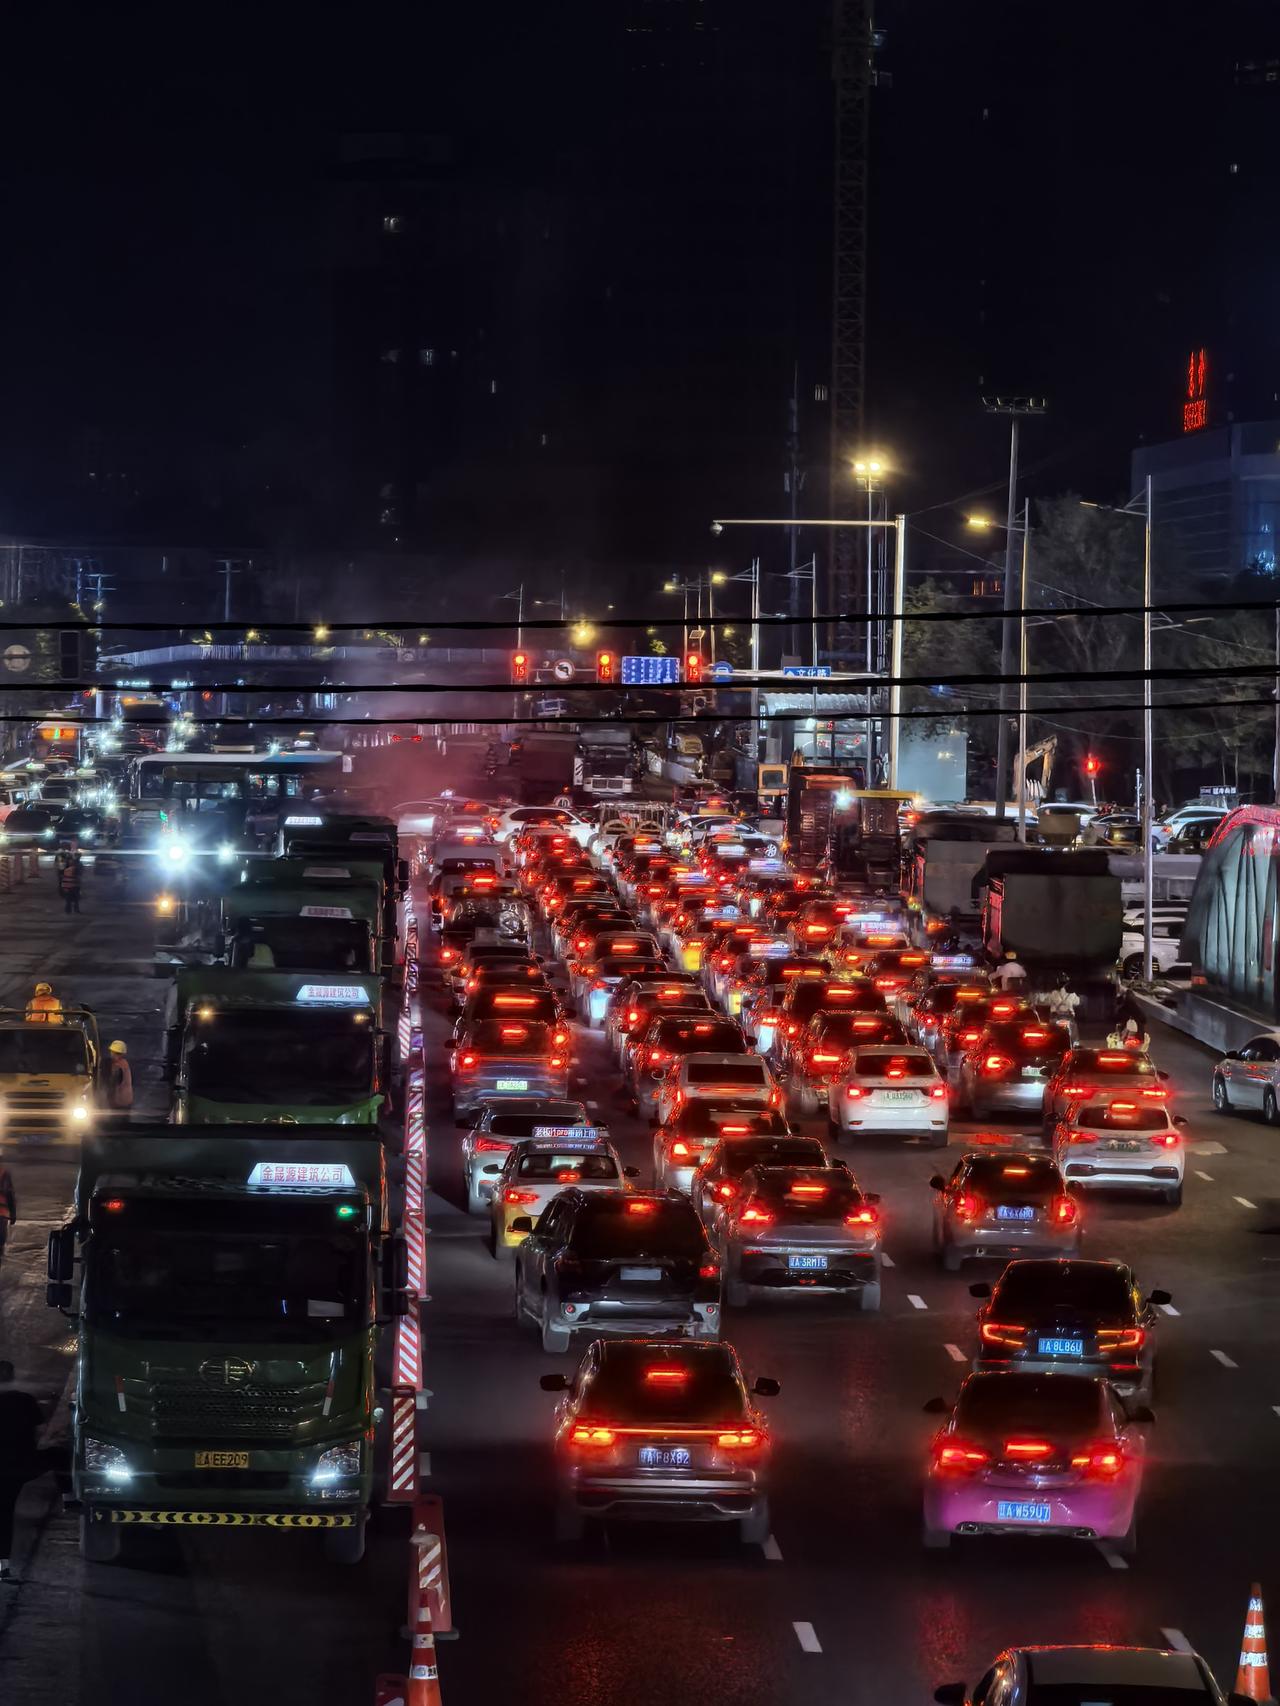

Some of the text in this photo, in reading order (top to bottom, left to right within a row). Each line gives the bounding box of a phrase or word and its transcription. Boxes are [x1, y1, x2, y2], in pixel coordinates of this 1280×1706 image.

[797, 668, 827, 677] 文化路
[262, 1165, 344, 1183] 金晟源建筑公司
